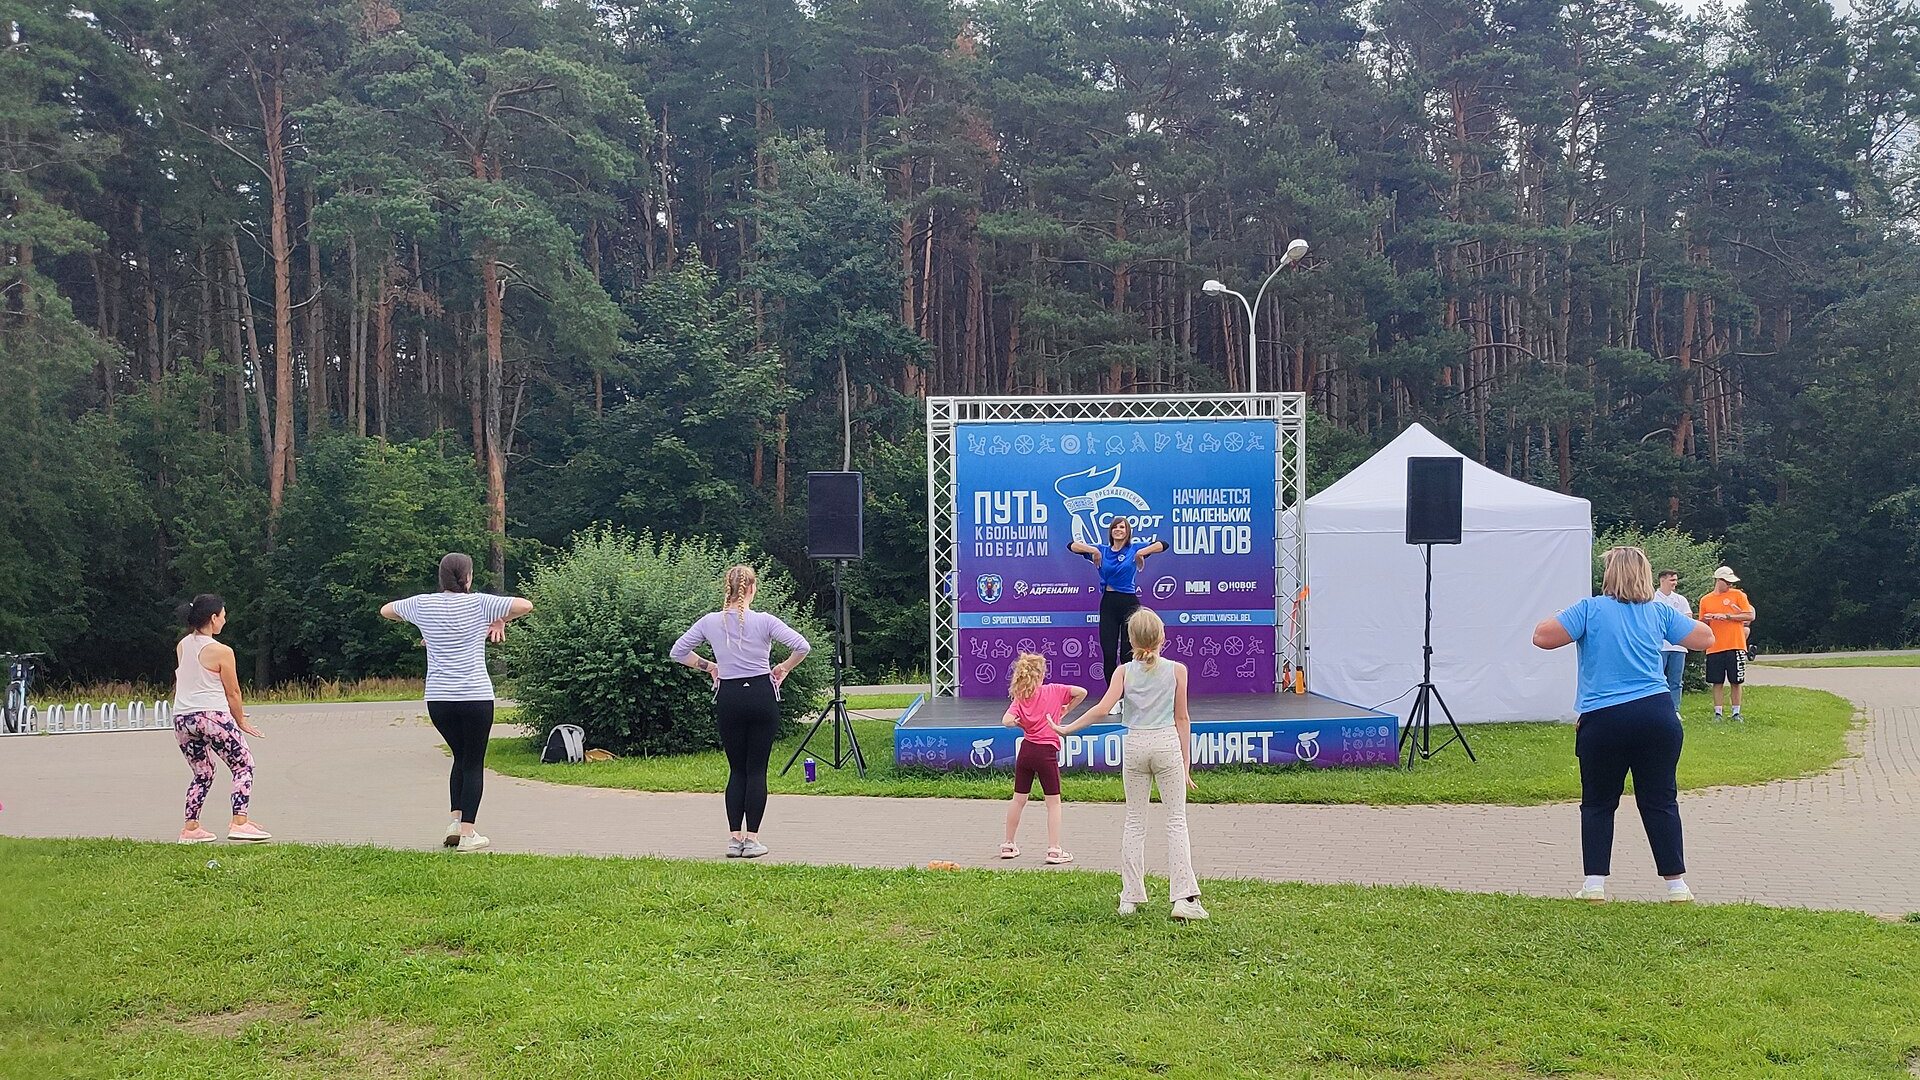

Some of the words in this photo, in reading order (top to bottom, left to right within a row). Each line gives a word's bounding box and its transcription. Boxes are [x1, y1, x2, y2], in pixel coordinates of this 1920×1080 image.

[1173, 488, 1250, 504] НАЧИНАЕТСЯ
[974, 490, 1048, 525] ПУТЬ
[1172, 508, 1180, 523] С
[1182, 507, 1251, 523] МАЛЕНЬКИХ
[1098, 512, 1164, 532] Сорт
[975, 526, 984, 540] К
[985, 525, 1048, 540] БОЛЬШИМ
[1173, 525, 1251, 554] ШАГОВ
[975, 541, 1048, 558] ПОБЕДАМ
[1029, 586, 1080, 595] АДРЕНАЛИН
[1229, 581, 1257, 589] НОВОЕ
